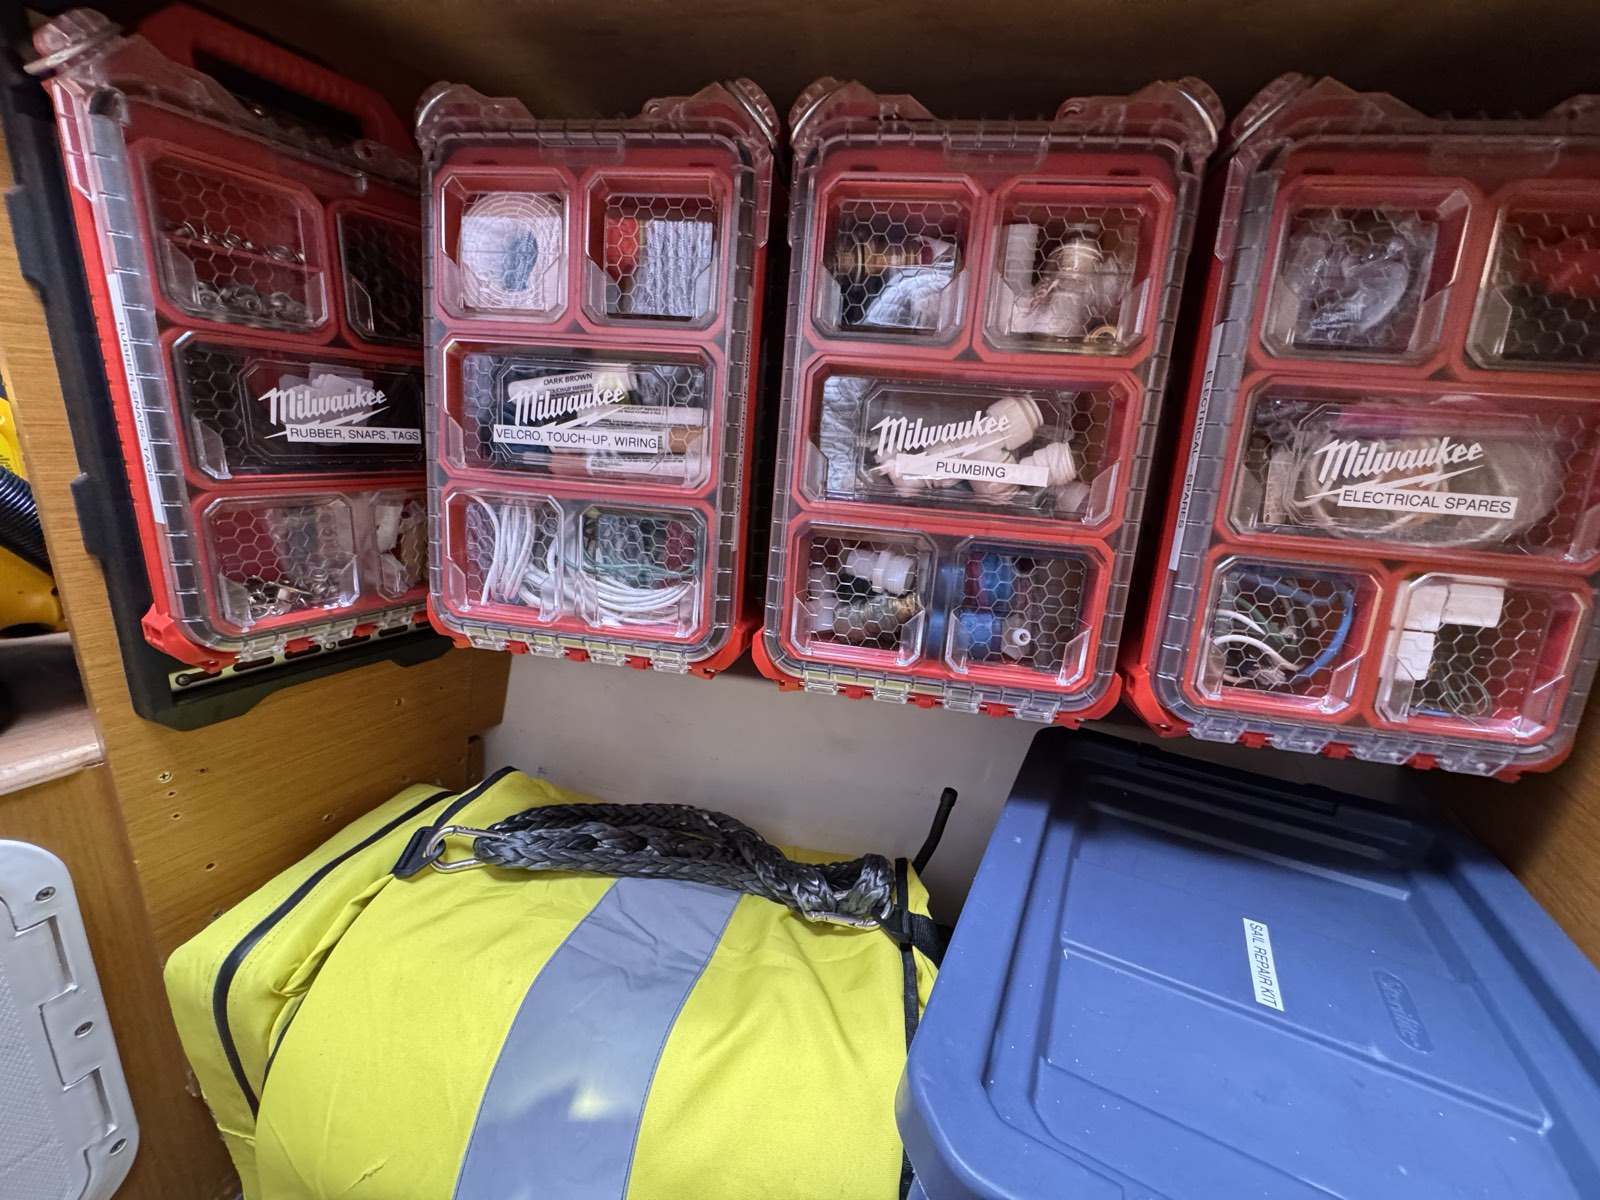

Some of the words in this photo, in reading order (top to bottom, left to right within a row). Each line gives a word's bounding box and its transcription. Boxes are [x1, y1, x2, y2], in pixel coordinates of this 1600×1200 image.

[543, 376, 564, 386] DARK
[564, 372, 593, 383] BROWN
[258, 386, 387, 426] Milwaukee
[508, 383, 625, 426] Milwaukee
[1190, 369, 1213, 456] ELECTRICAL
[290, 427, 346, 440] RUBBER,
[348, 430, 389, 441] SNAPS,
[393, 431, 419, 441] TAGS
[495, 428, 544, 442] VELCRO,
[547, 431, 611, 447] TOUCH-UP,
[614, 436, 657, 449] WIRING
[870, 410, 1012, 457] Milwaukee
[935, 461, 1006, 478] PLUMBING
[1313, 437, 1484, 484] Milwaukee
[1177, 474, 1194, 529] SPARES
[1342, 489, 1439, 509] ELECTRICAL
[1444, 497, 1512, 514] SPARES
[1249, 922, 1265, 943] SAIL
[1254, 945, 1273, 986] REPAIR
[1260, 986, 1278, 1007] KIT
